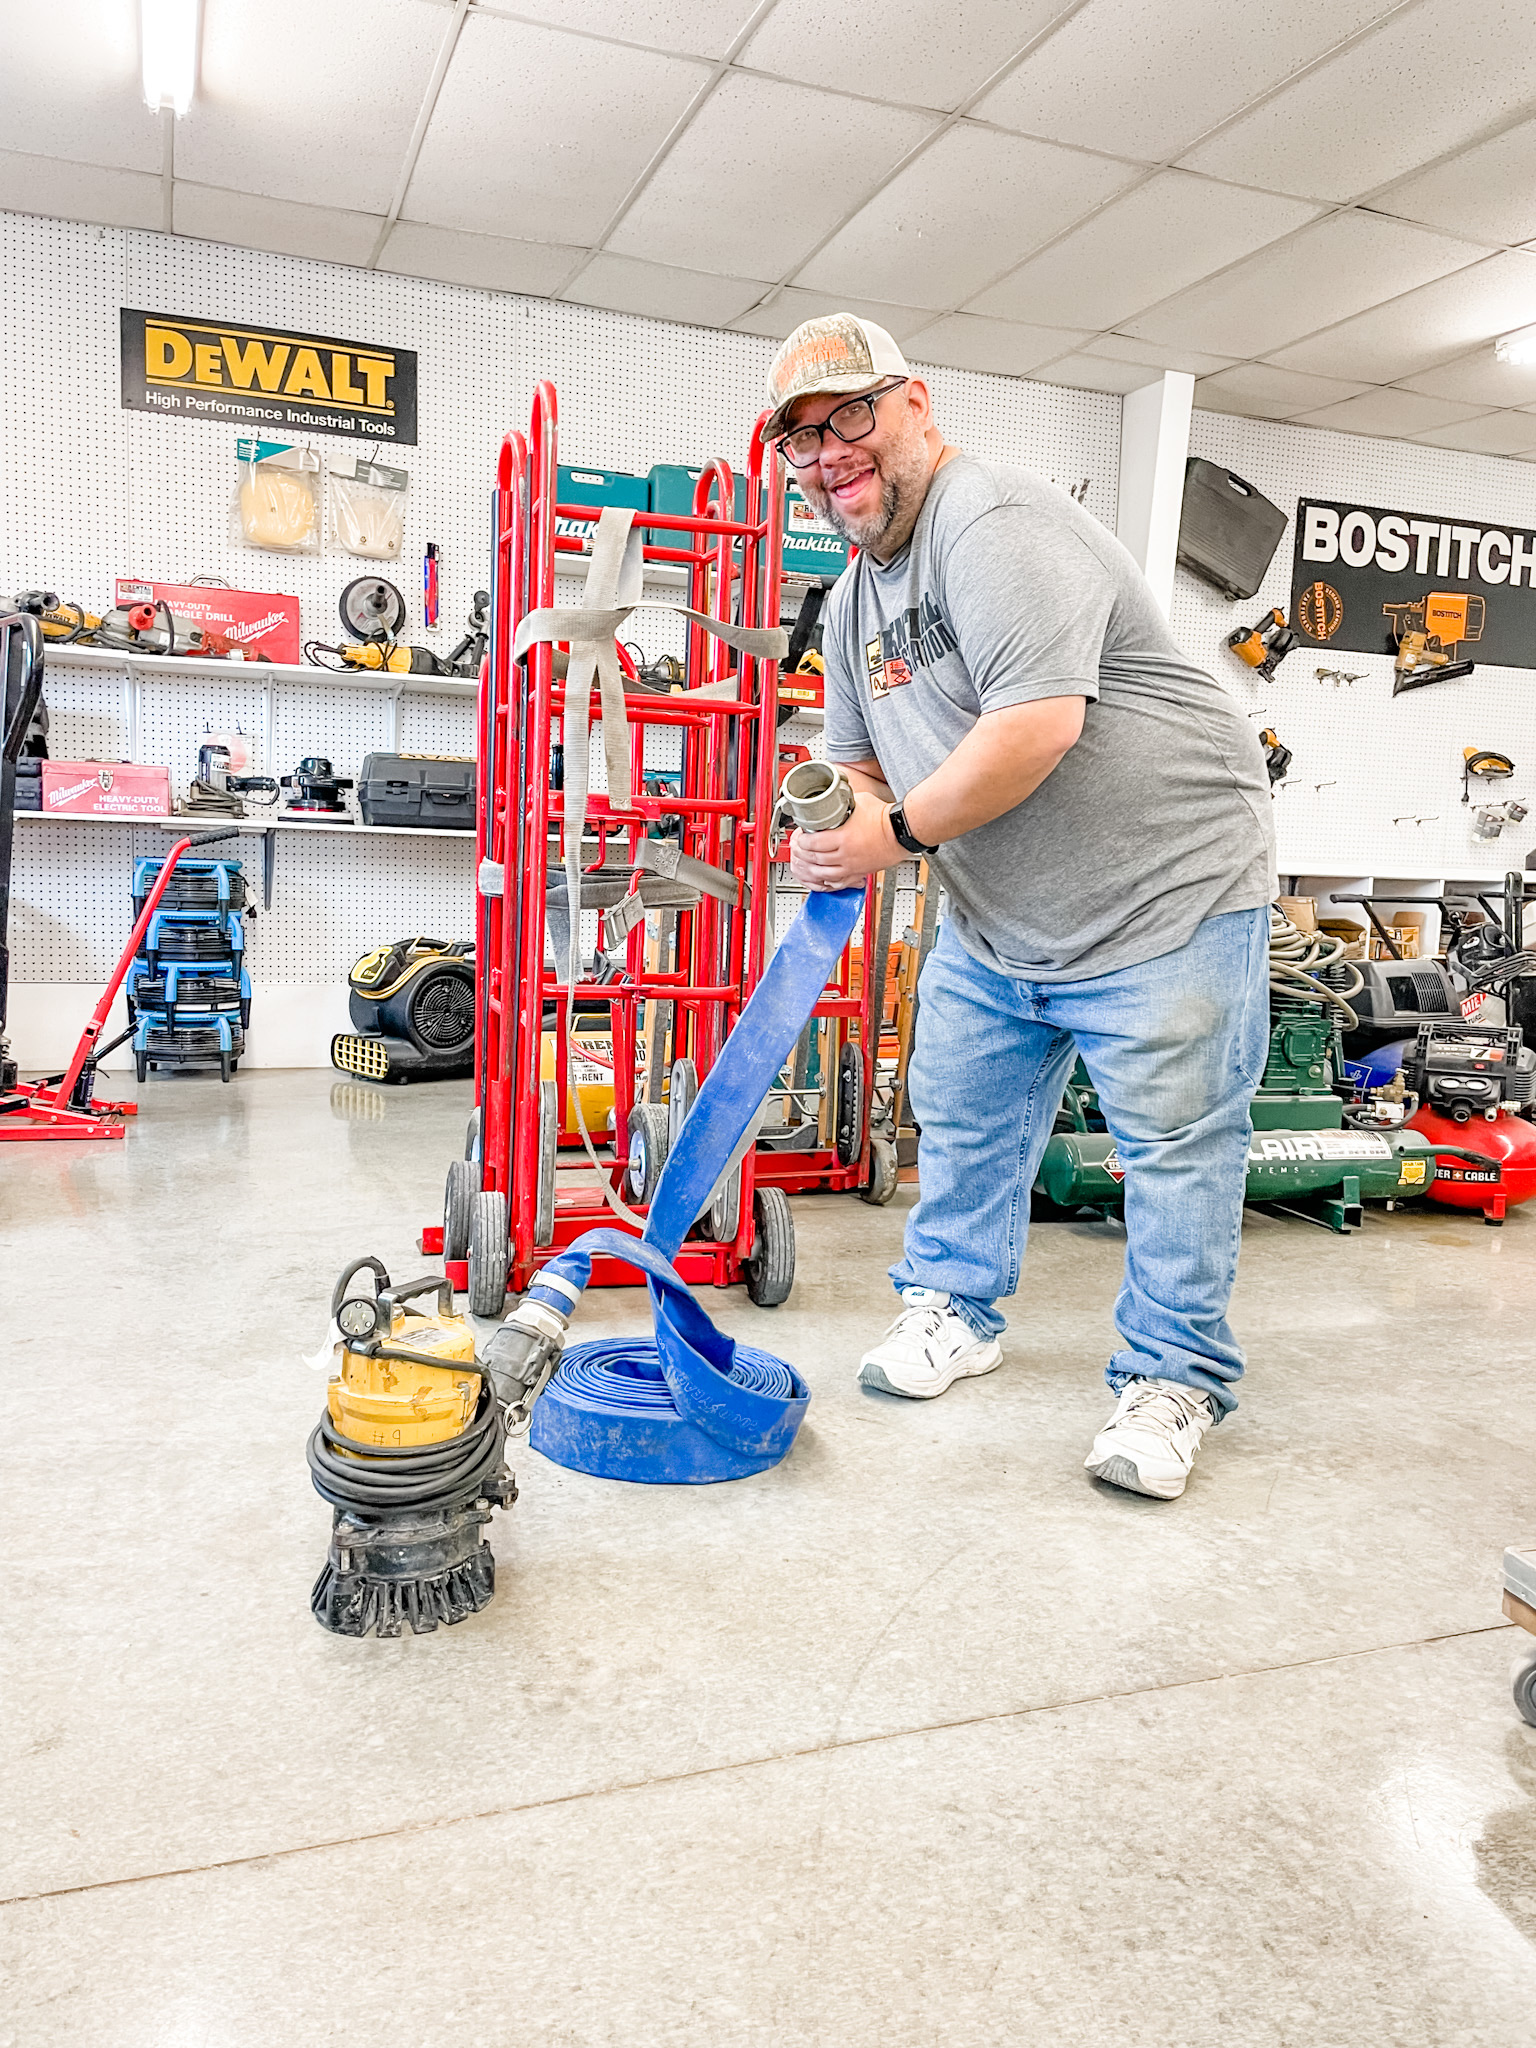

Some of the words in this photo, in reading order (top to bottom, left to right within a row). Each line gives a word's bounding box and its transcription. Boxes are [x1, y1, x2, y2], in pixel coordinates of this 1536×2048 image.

[145, 326, 395, 408] DEWALT
[145, 391, 181, 409] High
[185, 397, 283, 421] Performance
[287, 412, 355, 431] Industrial
[357, 419, 396, 436] Tools
[1302, 506, 1536, 588] BOSTITCH
[154, 599, 212, 611] AVY-DUTY
[1314, 582, 1327, 640] BOSTITCH
[1432, 609, 1462, 619] BOSTITCH
[206, 612, 236, 622] DRILL
[223, 611, 286, 641] Milwaukee
[99, 795, 160, 804] HEAVY-DUTY
[93, 803, 139, 812] ELECTRIC
[140, 804, 167, 812] TOOL
[1246, 1166, 1299, 1174] STEMS
[1464, 1171, 1496, 1182] CABLE
